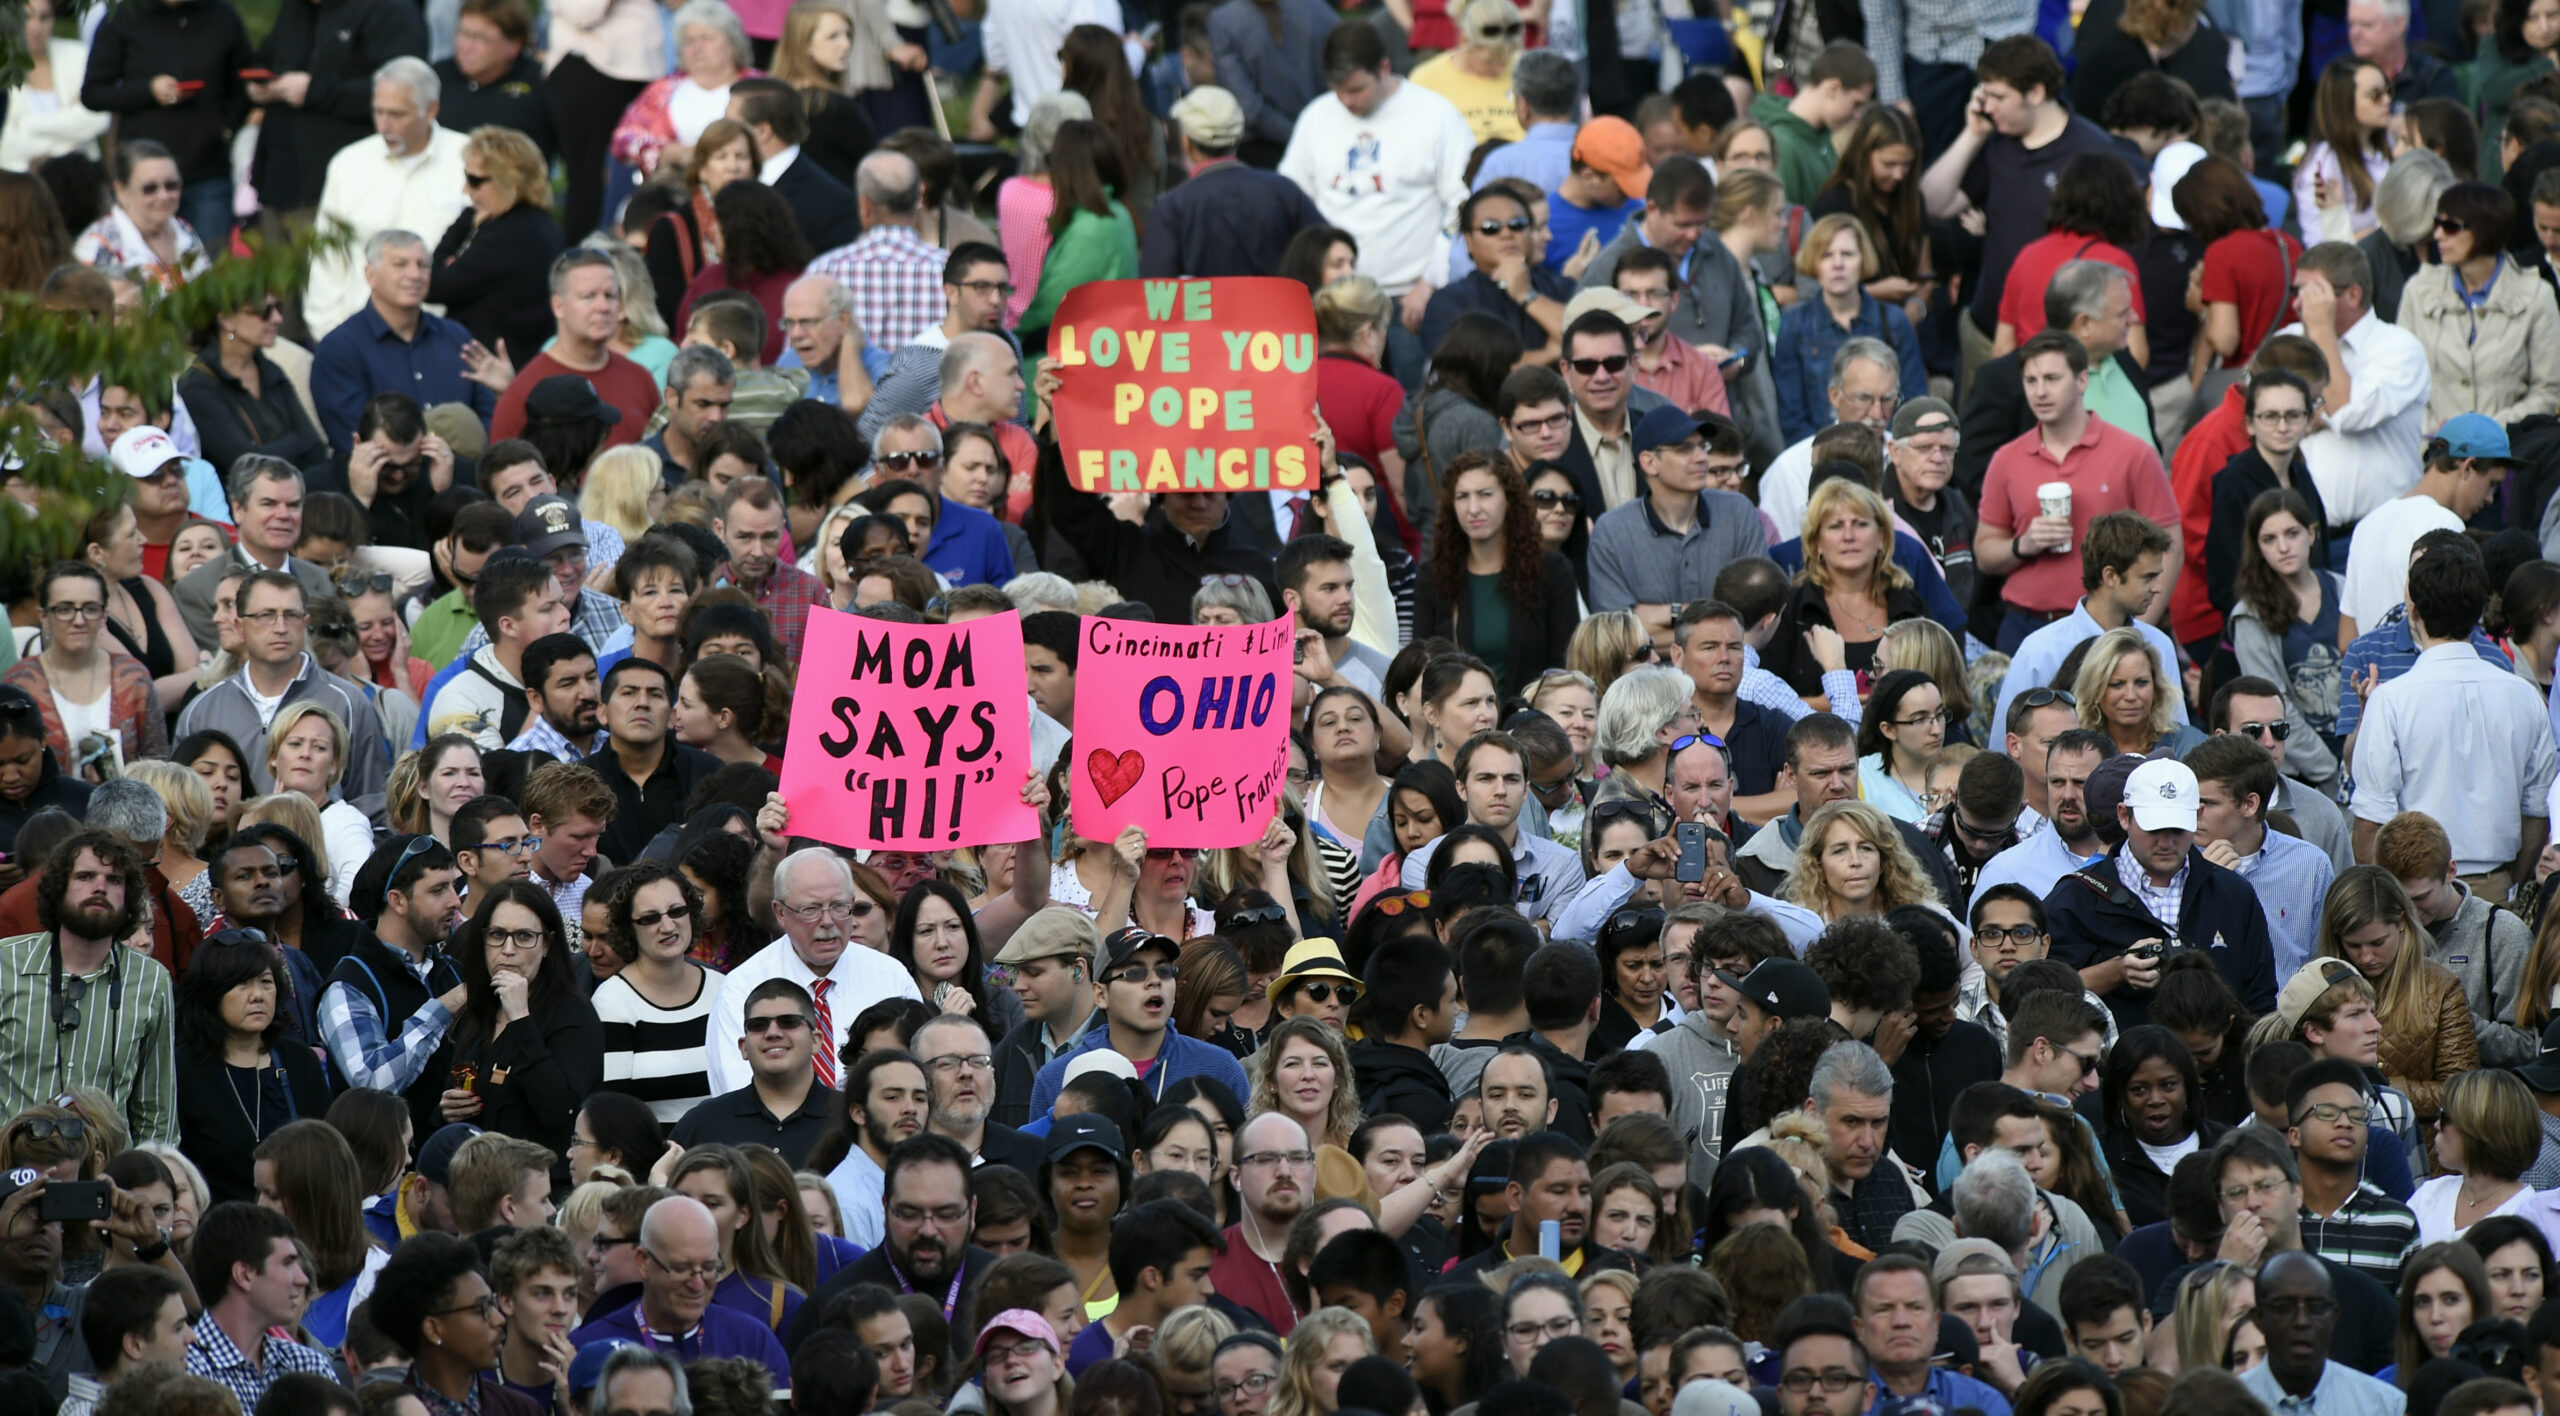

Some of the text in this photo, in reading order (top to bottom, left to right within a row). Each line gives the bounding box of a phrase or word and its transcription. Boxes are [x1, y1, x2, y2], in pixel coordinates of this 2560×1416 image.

[1144, 280, 1213, 321] WE
[1060, 325, 1314, 374] LOVE YOU
[1114, 382, 1255, 431] POPE
[1078, 444, 1307, 491] FRANCIS
[546, 522, 570, 533] NAVY
[850, 628, 976, 690] MOM
[1089, 620, 1224, 659] Cincinnati
[1138, 671, 1276, 736] OHIO
[818, 696, 1003, 769] SAYS,
[1162, 736, 1287, 823] Pope Francis
[2083, 874, 2109, 893] DIGITAL
[1703, 1076, 1729, 1092] LIFE
[10, 1168, 37, 1187] W
